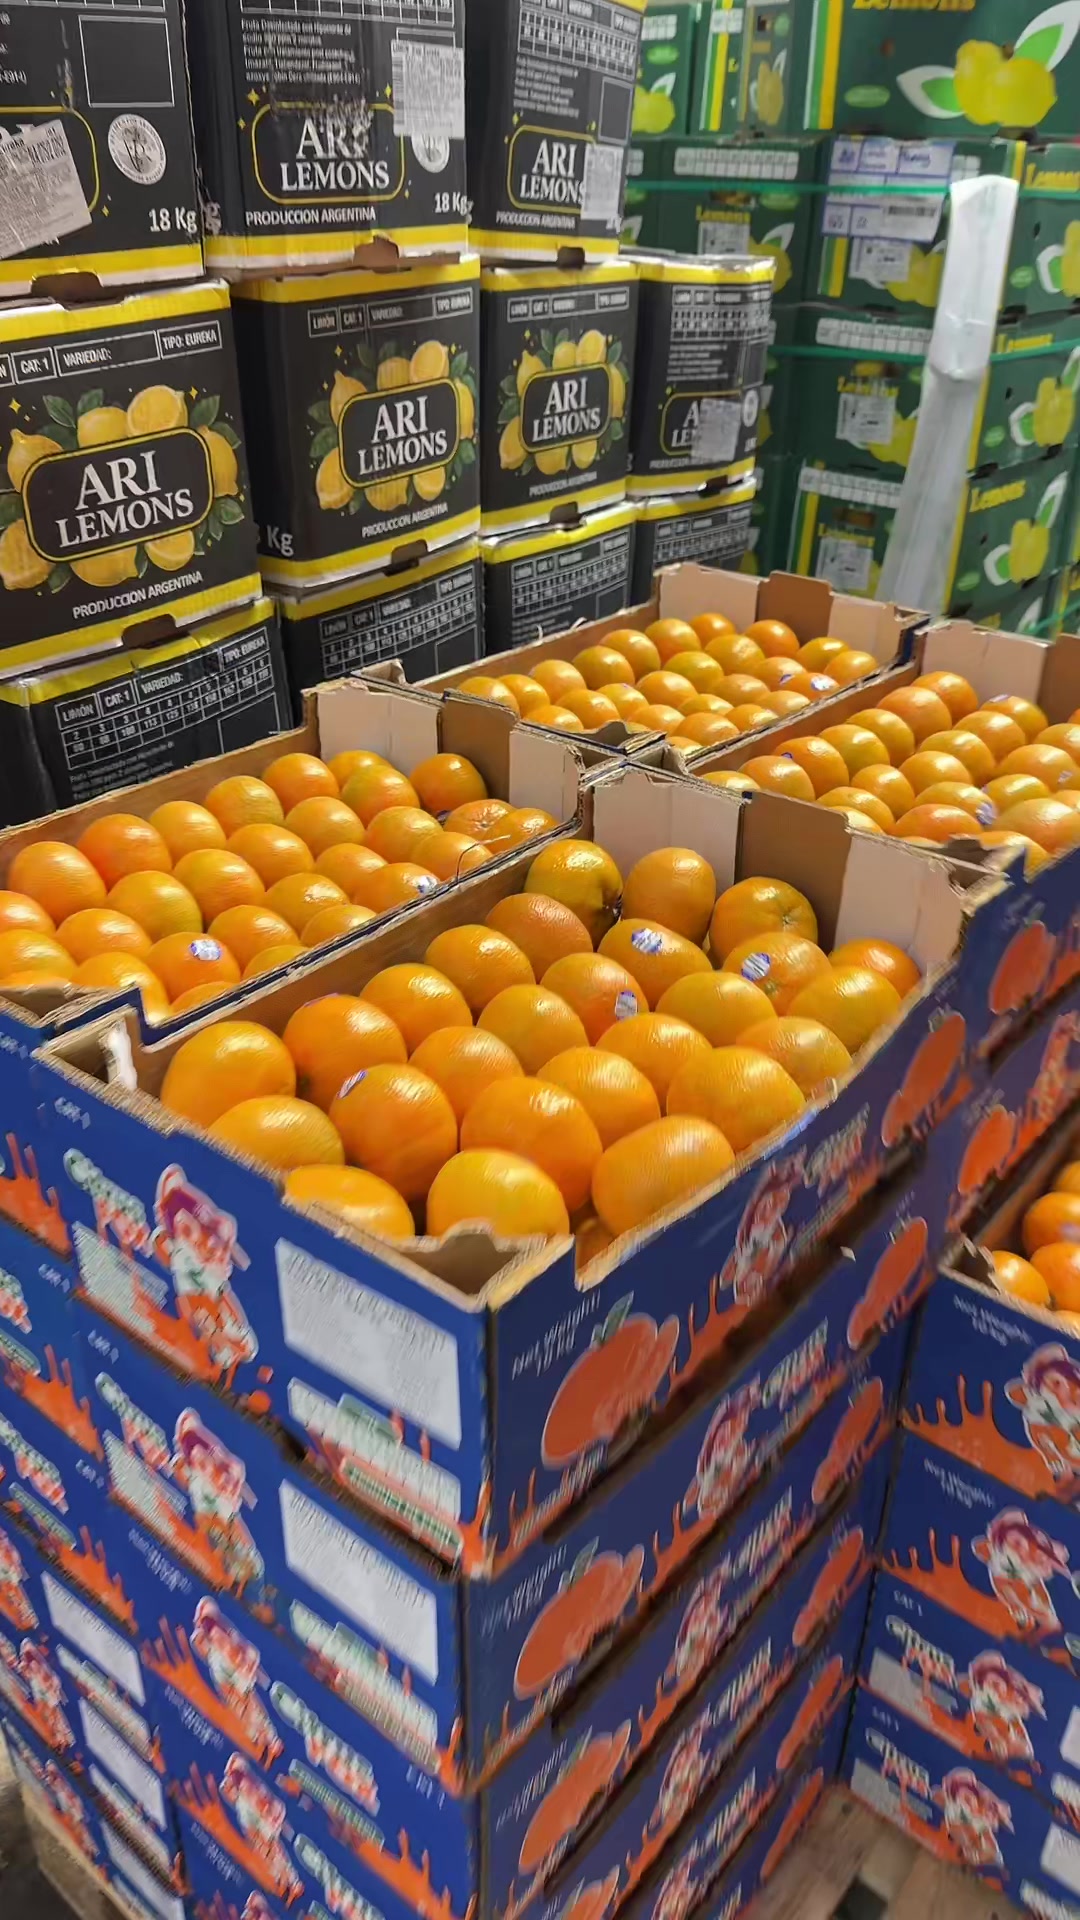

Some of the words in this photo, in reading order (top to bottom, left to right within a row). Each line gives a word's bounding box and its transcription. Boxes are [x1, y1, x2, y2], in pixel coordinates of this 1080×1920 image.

[280, 160, 390, 191] LEMONS
[532, 138, 577, 178] ARI
[149, 208, 171, 232] 18
[175, 207, 197, 232] Kg
[245, 208, 320, 227] PRODUCCION
[321, 206, 376, 223] ARGENTINA
[434, 192, 450, 214] 18
[162, 336, 185, 350] TIPO:
[185, 328, 218, 346] EUREKA
[544, 377, 588, 416] ARI
[371, 396, 429, 443] ARI
[532, 407, 602, 443] LEMONS
[358, 430, 448, 475] LEMONS
[75, 449, 162, 511] ARI
[56, 488, 195, 549] LEMONS
[361, 514, 411, 538] PRODUCCION
[266, 525, 294, 556] Kg
[73, 590, 147, 620] PRODUCCION
[148, 570, 205, 600] ARGENTINA
